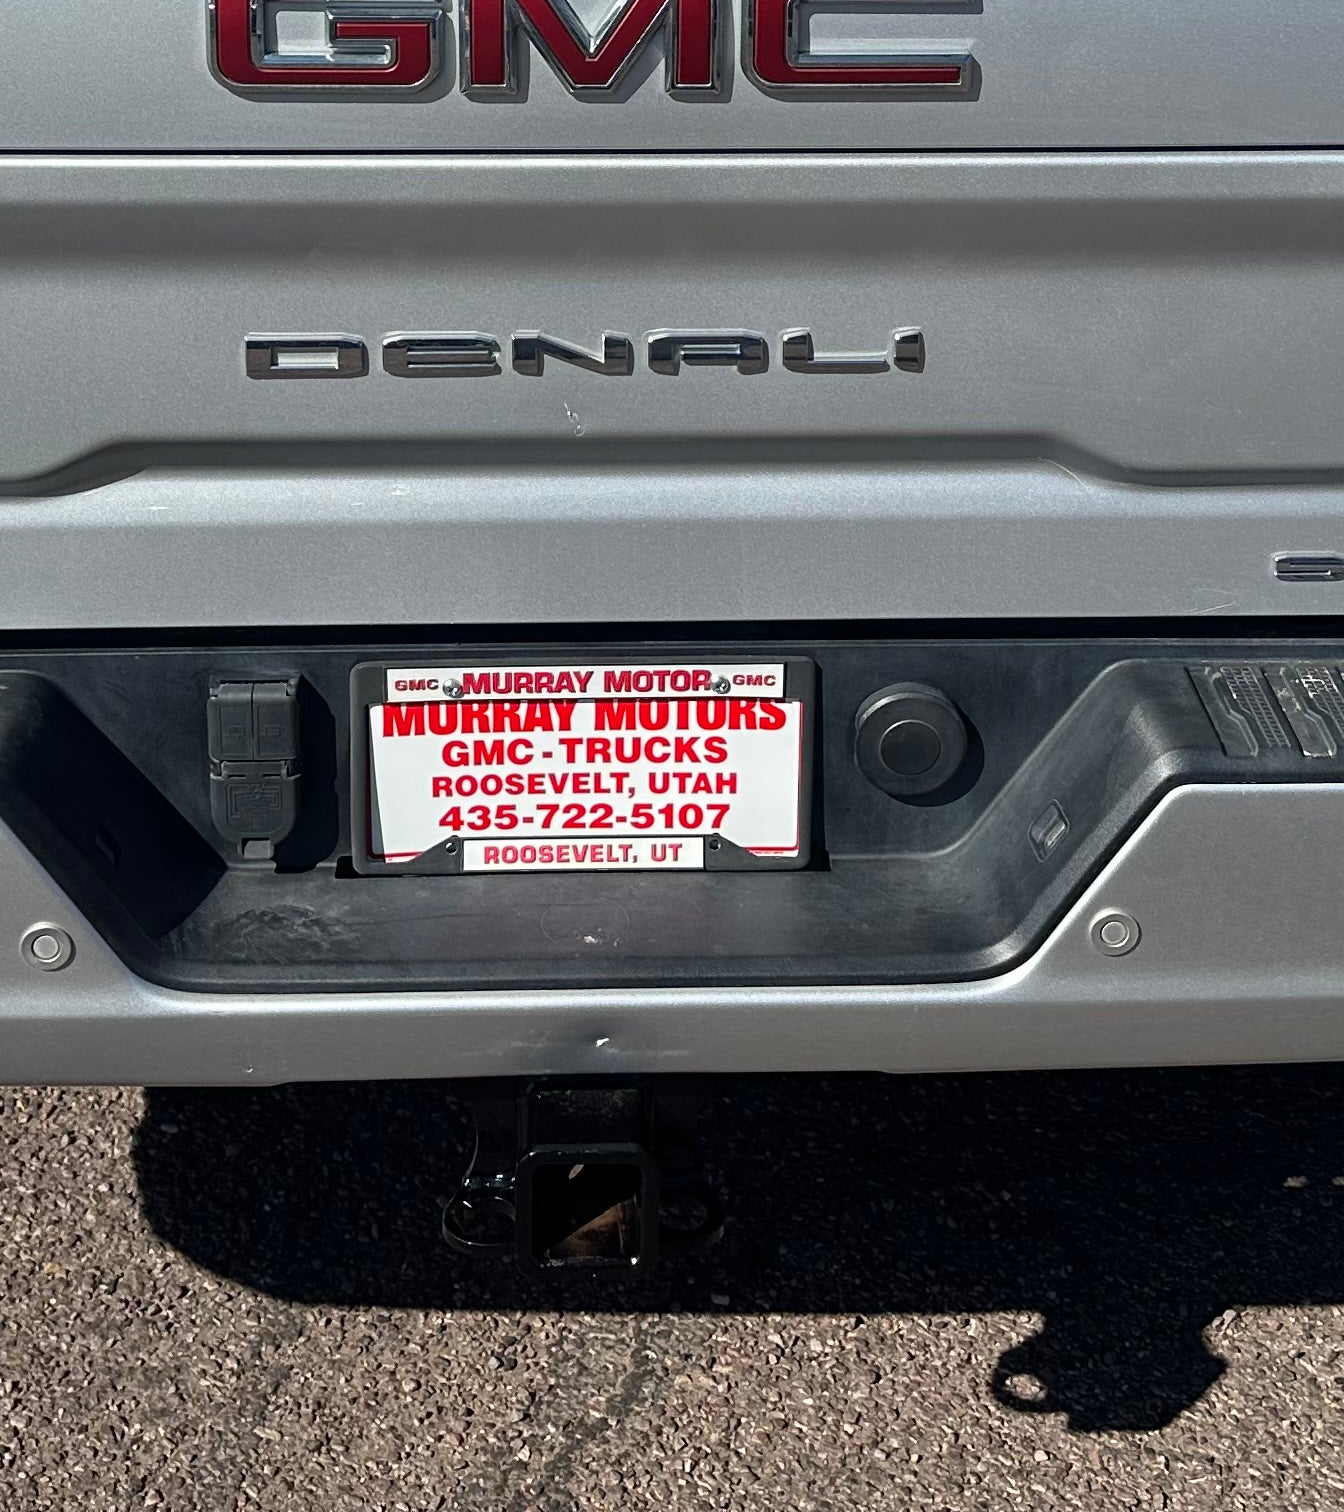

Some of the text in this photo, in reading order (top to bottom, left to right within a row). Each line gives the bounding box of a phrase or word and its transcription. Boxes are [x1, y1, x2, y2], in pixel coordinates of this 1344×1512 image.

[244, 327, 927, 377] DENALI
[394, 678, 440, 692] GMC
[462, 669, 712, 695] MURRAY MOTOR
[732, 674, 777, 687] GMC
[382, 698, 787, 738] MURRAY MOTORS
[442, 738, 534, 768] GMC
[558, 736, 729, 765] TRUCKS
[431, 771, 738, 799] ROOSEVELT, UTAH
[438, 803, 731, 832] 435-722-5107
[483, 843, 684, 865] ROOSEVELT, UT
